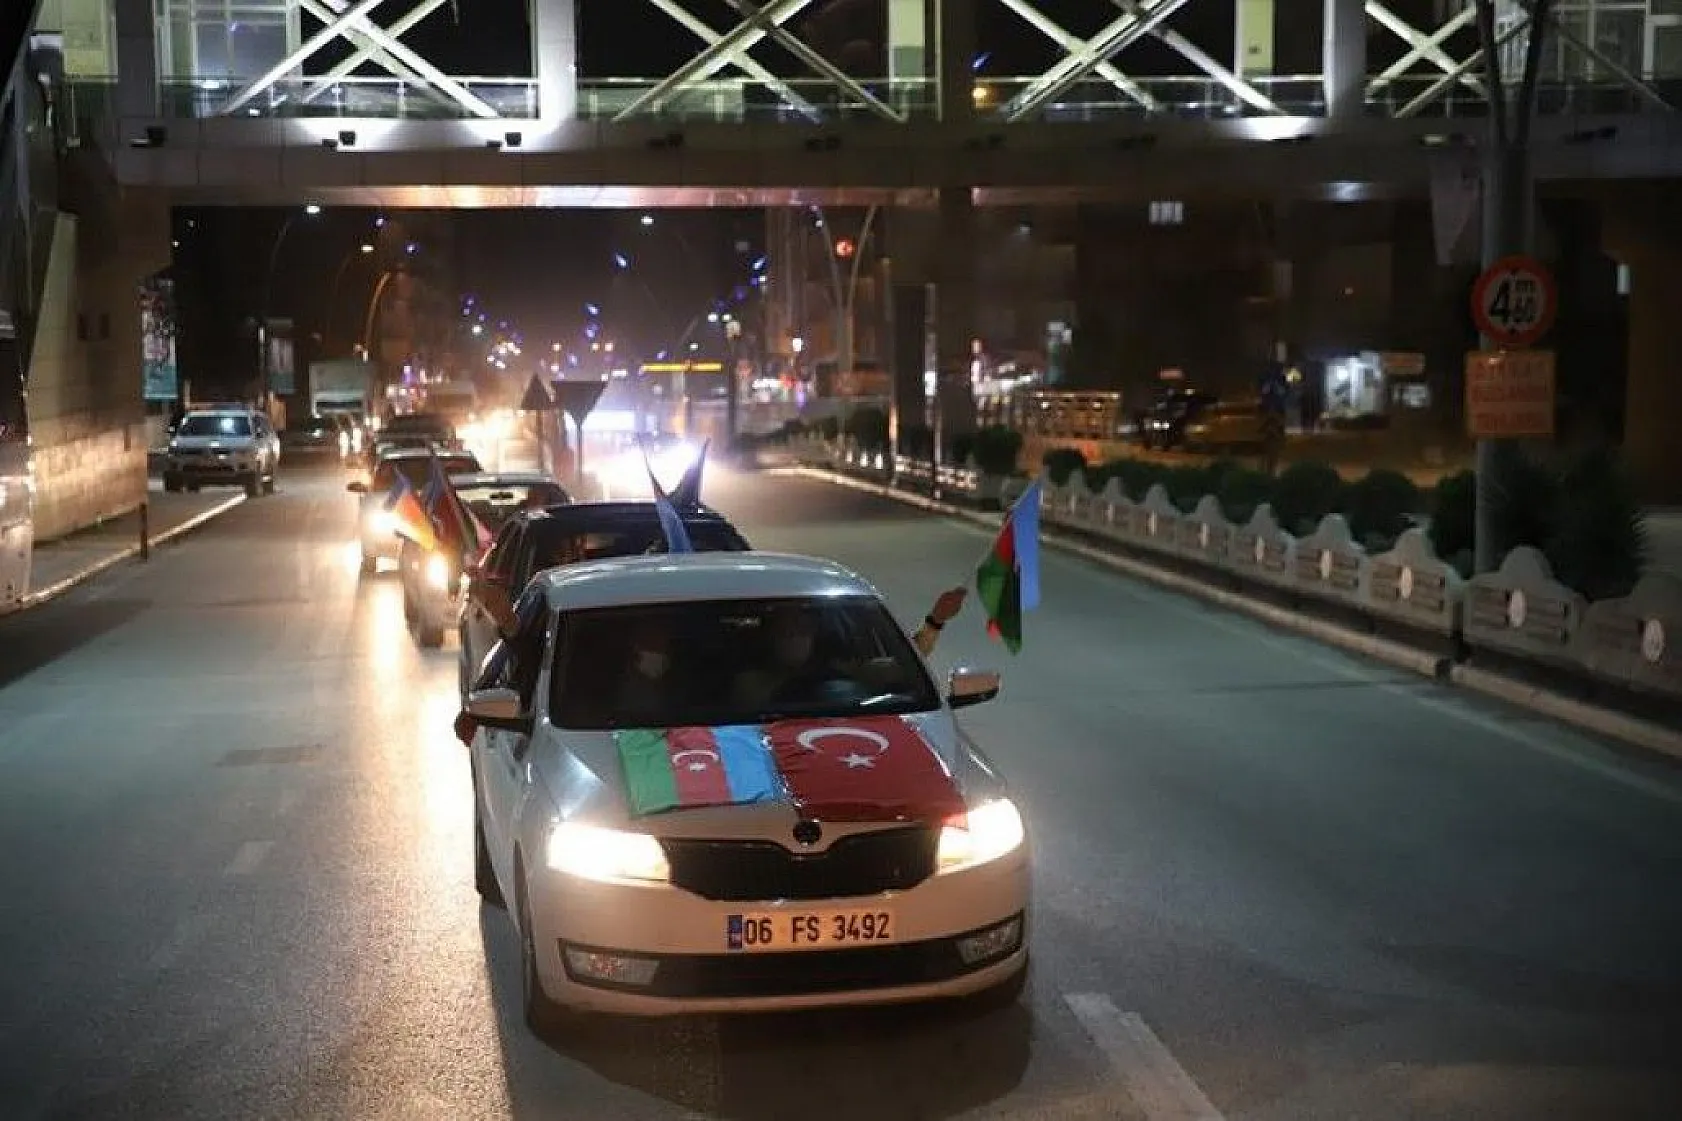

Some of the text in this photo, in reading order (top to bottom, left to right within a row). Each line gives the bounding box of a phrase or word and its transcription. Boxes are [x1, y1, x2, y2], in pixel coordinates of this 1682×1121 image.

[1489, 279, 1511, 326] 4
[745, 918, 773, 945] 06
[792, 915, 820, 943] FS
[832, 912, 890, 941] 3492
